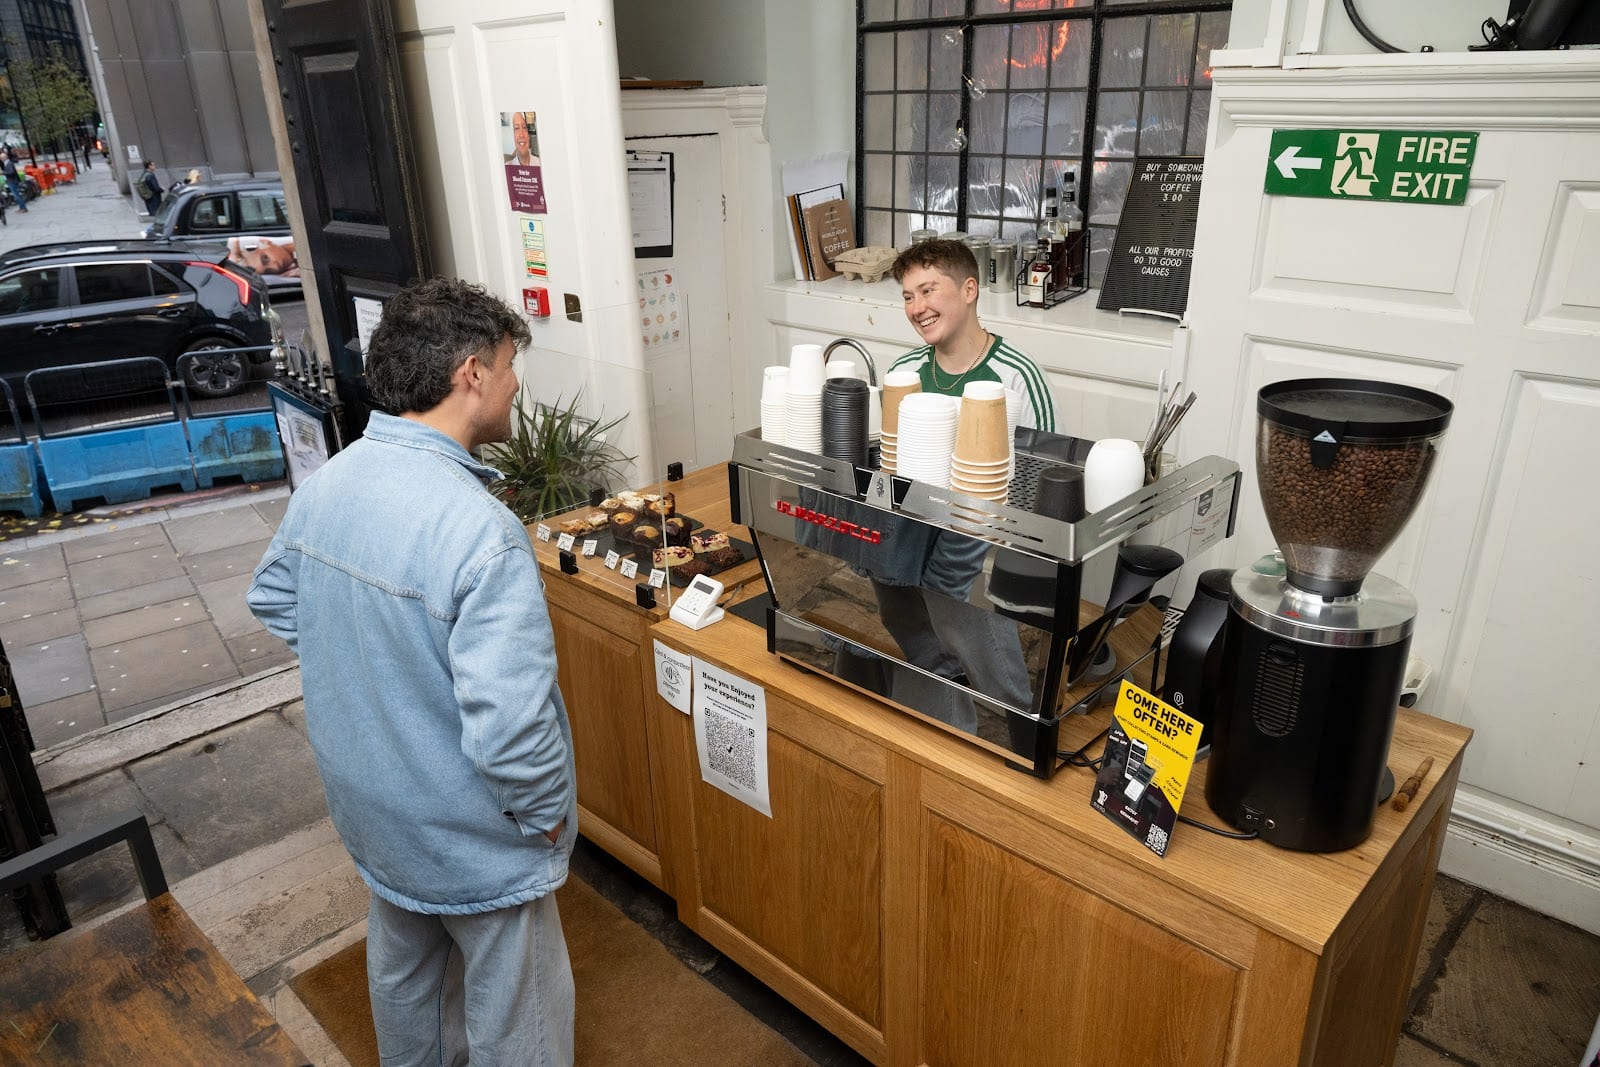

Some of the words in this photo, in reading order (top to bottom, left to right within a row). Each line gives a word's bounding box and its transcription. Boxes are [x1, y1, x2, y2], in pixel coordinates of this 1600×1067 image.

[1397, 136, 1471, 164] FIRE
[1146, 163, 1161, 172] BUY
[1168, 163, 1204, 172] SOMEONE
[1140, 173, 1155, 182] PAY
[1160, 173, 1168, 182] IT
[1160, 184, 1192, 192] COFFEE
[1390, 172, 1463, 199] EXIT
[824, 240, 850, 254] COFFEE
[1129, 246, 1141, 254] ALL
[1144, 246, 1159, 256] OUR
[1164, 248, 1194, 258] PROFITS
[1134, 256, 1144, 264] GO
[1148, 256, 1157, 265] TO
[1160, 258, 1182, 267] GOOD
[1141, 266, 1170, 276] CAUSES
[702, 672, 717, 684] Have
[718, 681, 730, 690] you
[730, 684, 755, 701] Enjoyed
[704, 682, 718, 693] your
[719, 689, 755, 710] experience?
[1126, 689, 1159, 715] COME
[1161, 708, 1194, 735] HERE
[1134, 708, 1178, 740] OFTEN?
